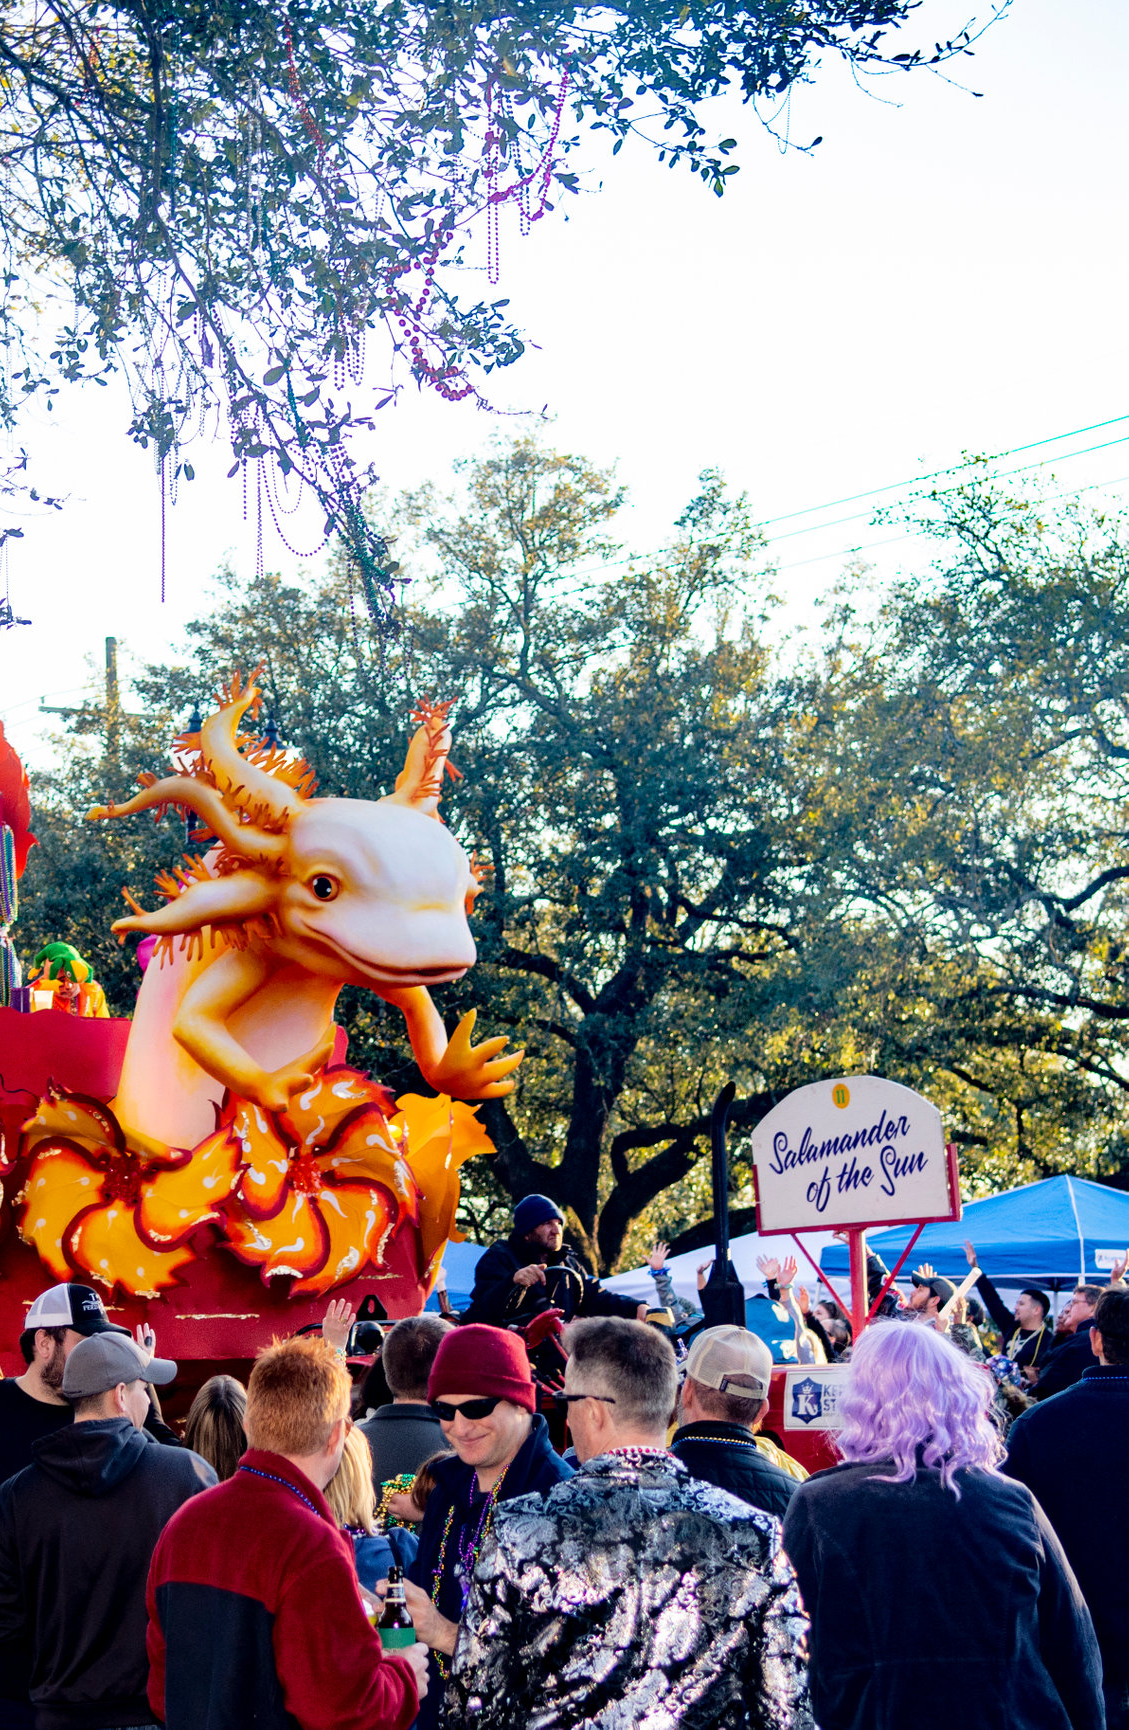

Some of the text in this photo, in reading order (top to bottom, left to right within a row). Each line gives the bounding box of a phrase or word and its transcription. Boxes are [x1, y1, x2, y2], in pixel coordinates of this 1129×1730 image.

[836, 1089, 845, 1104] 11
[768, 1109, 910, 1175] Salamander
[806, 1145, 928, 1212] of the Sun
[797, 1394, 818, 1416] K
